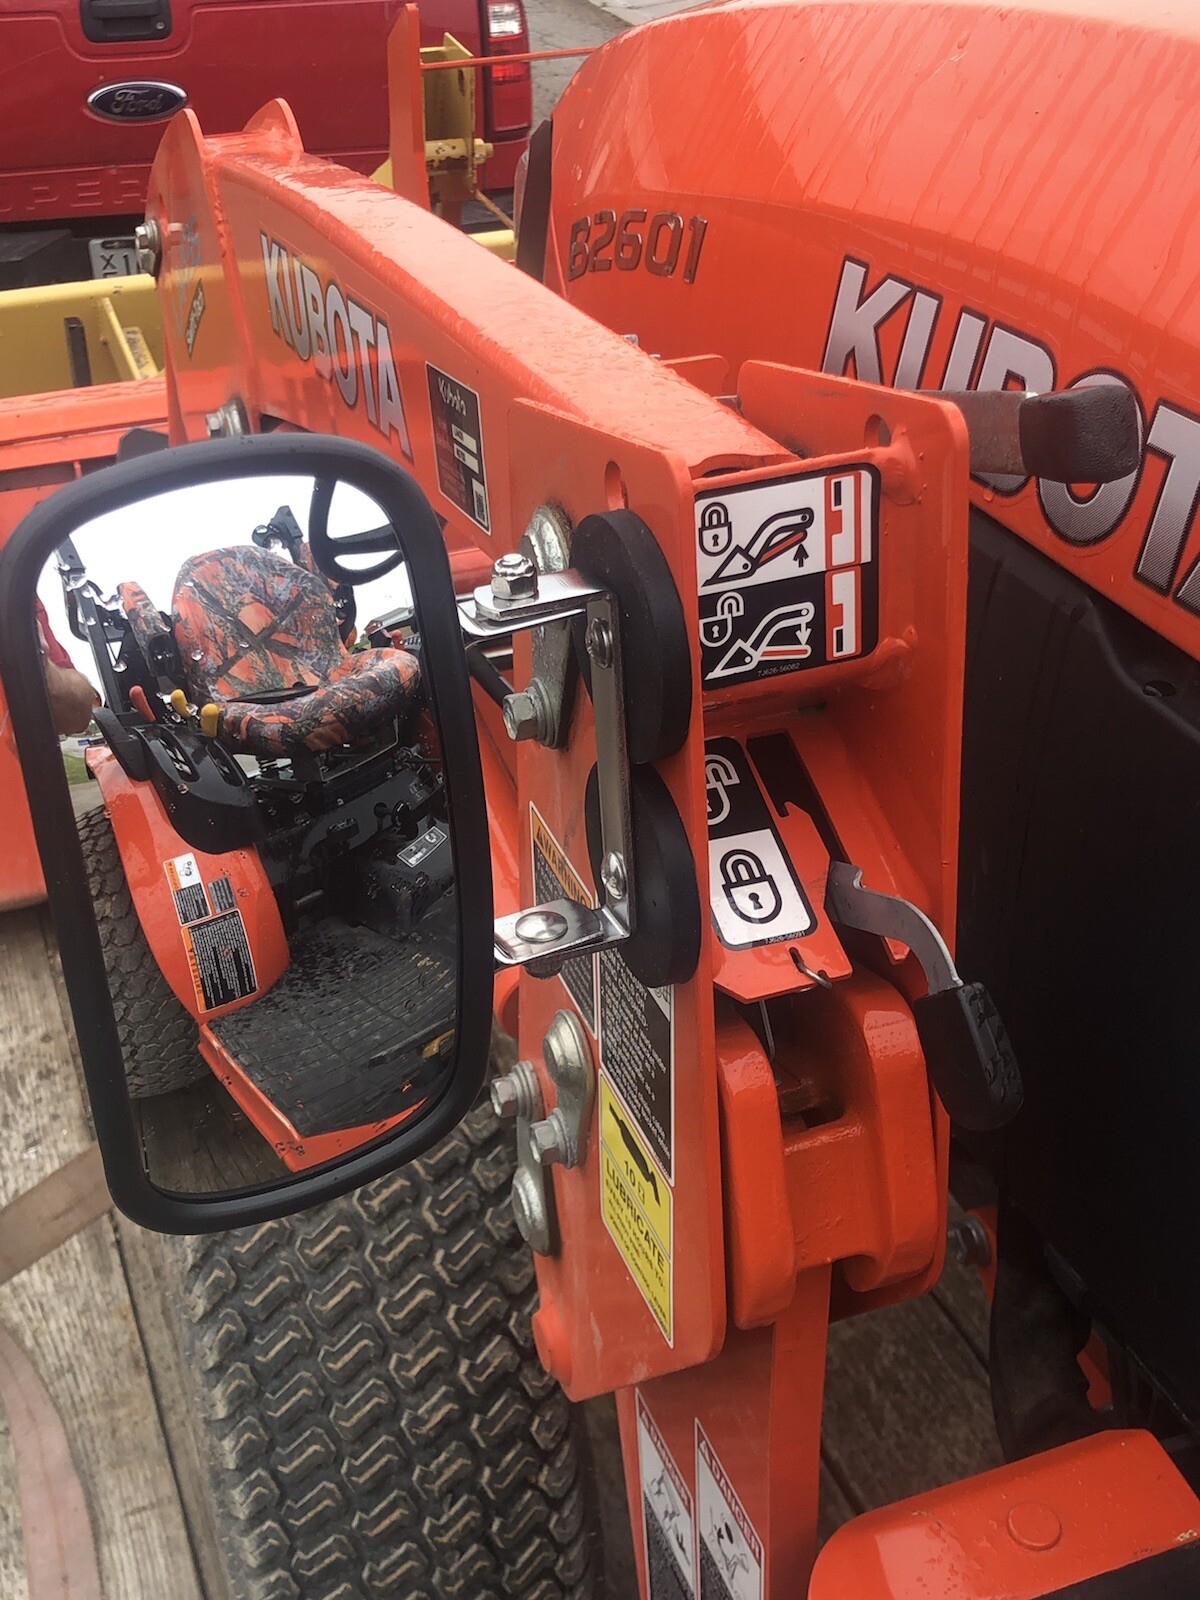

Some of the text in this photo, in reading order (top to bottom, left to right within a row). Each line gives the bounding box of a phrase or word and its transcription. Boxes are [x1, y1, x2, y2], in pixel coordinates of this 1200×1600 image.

[111, 88, 164, 114] Ford
[567, 207, 709, 285] B2601
[260, 229, 414, 467] KUBOTA
[624, 1160, 636, 1188] 10
[605, 1157, 665, 1275] LUBRICATE
